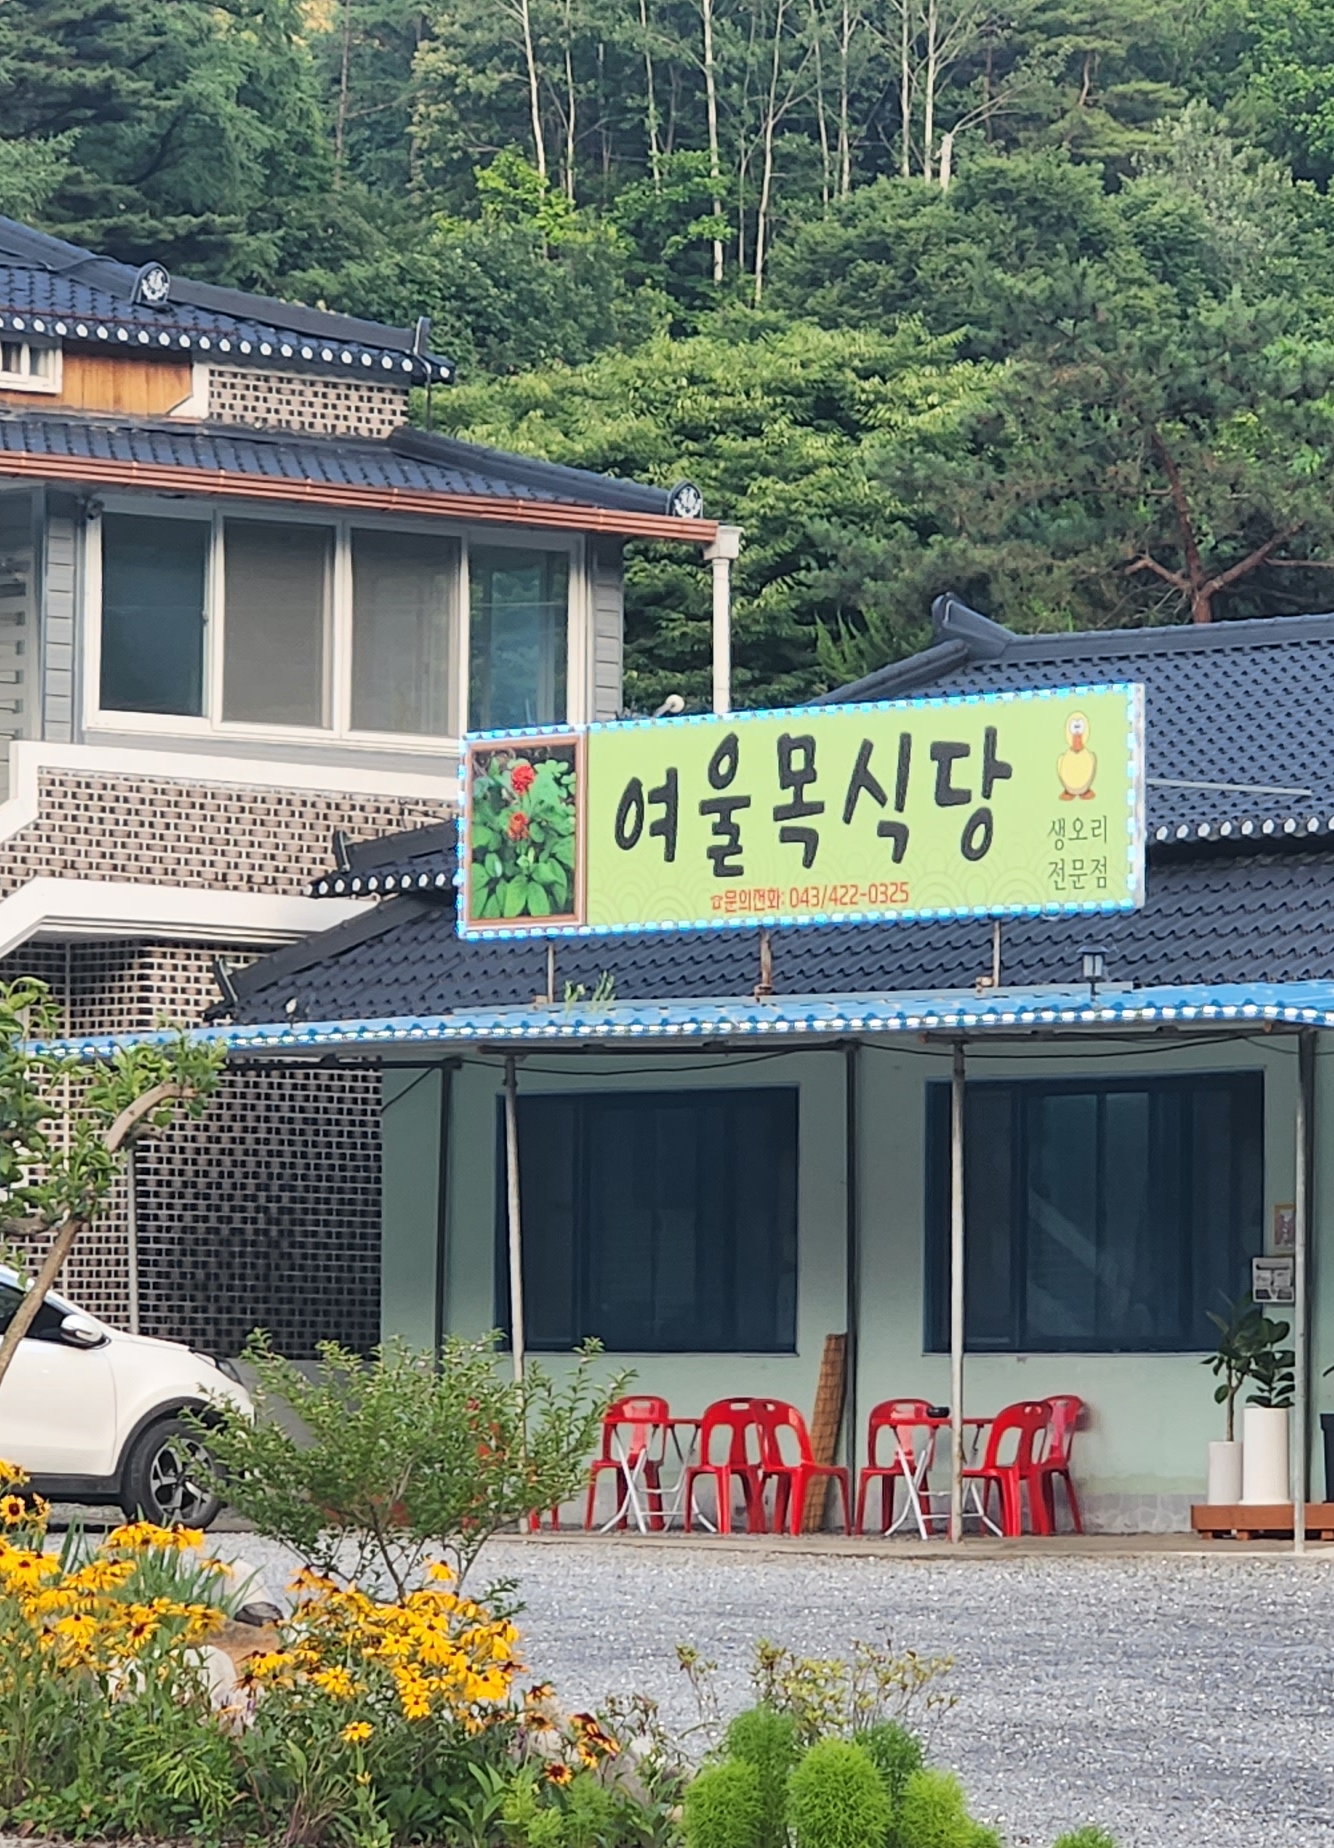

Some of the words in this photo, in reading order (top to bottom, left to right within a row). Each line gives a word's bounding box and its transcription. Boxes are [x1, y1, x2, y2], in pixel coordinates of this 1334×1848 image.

[614, 725, 1013, 878] 여울목식당
[1047, 815, 1107, 851] 생오리
[1048, 856, 1107, 891] 전문점
[789, 882, 909, 909] 043/422-0325
